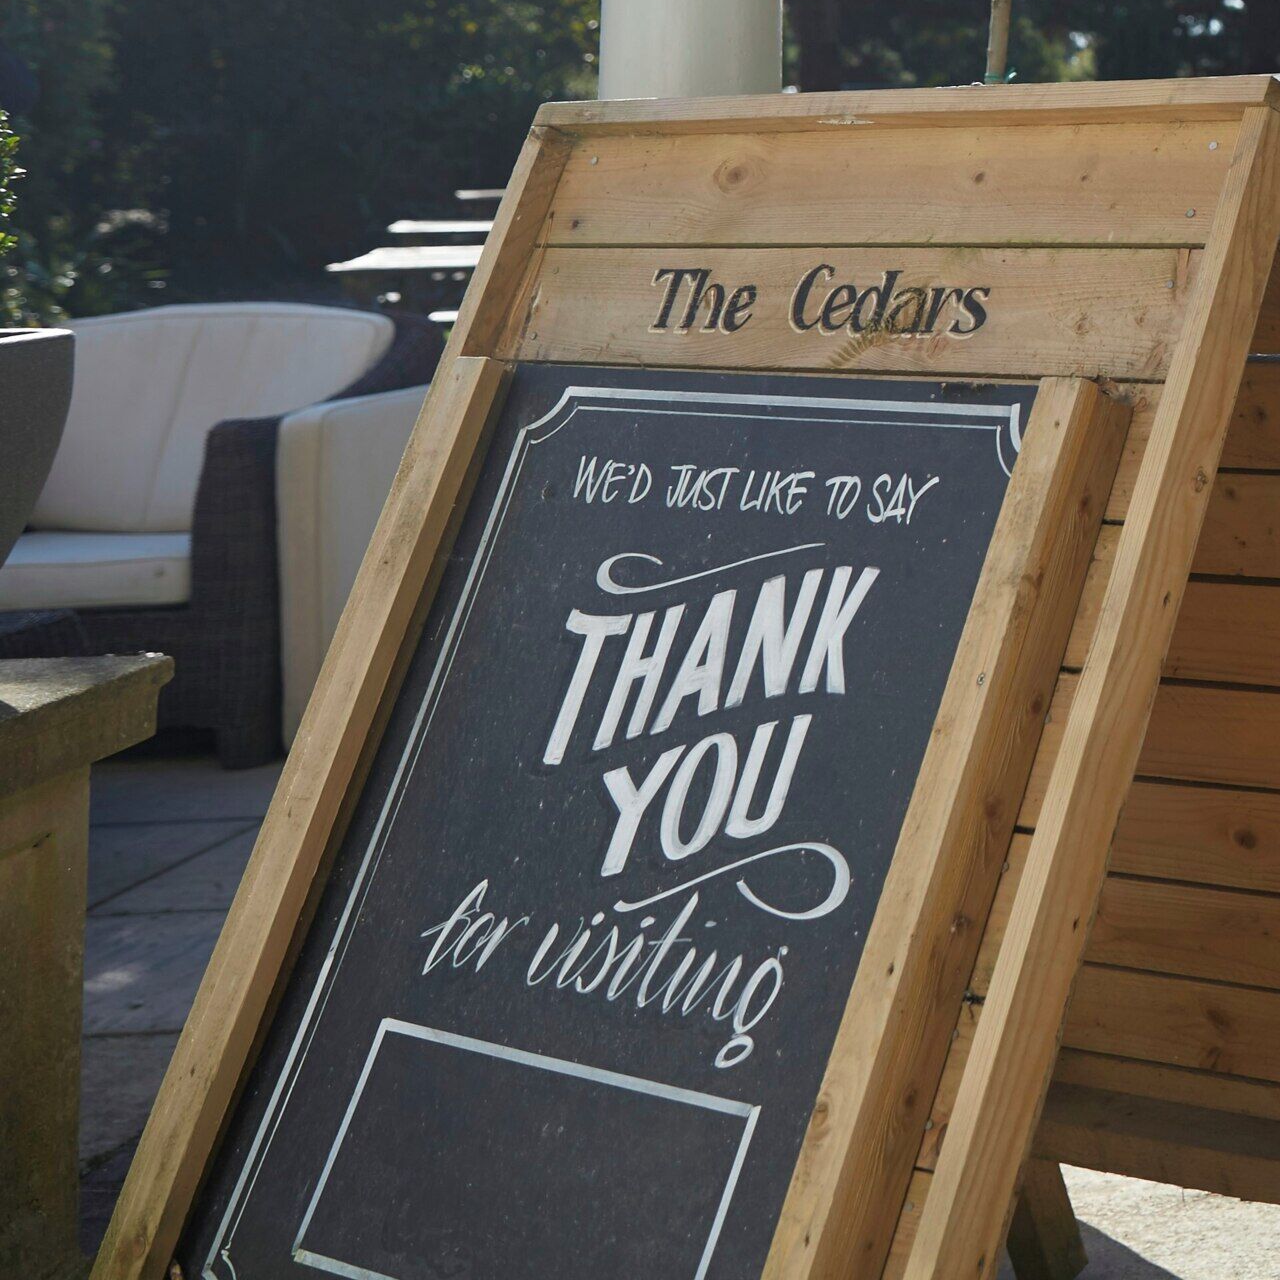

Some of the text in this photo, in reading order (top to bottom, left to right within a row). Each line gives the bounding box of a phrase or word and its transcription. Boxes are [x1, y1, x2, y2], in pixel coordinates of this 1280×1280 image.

[648, 263, 991, 340] The Cedars
[573, 455, 939, 525] WE'D JUST LIKE TO SAY
[542, 565, 880, 766] THANK
[601, 713, 813, 877] YOU
[420, 879, 788, 1068] for visiting
